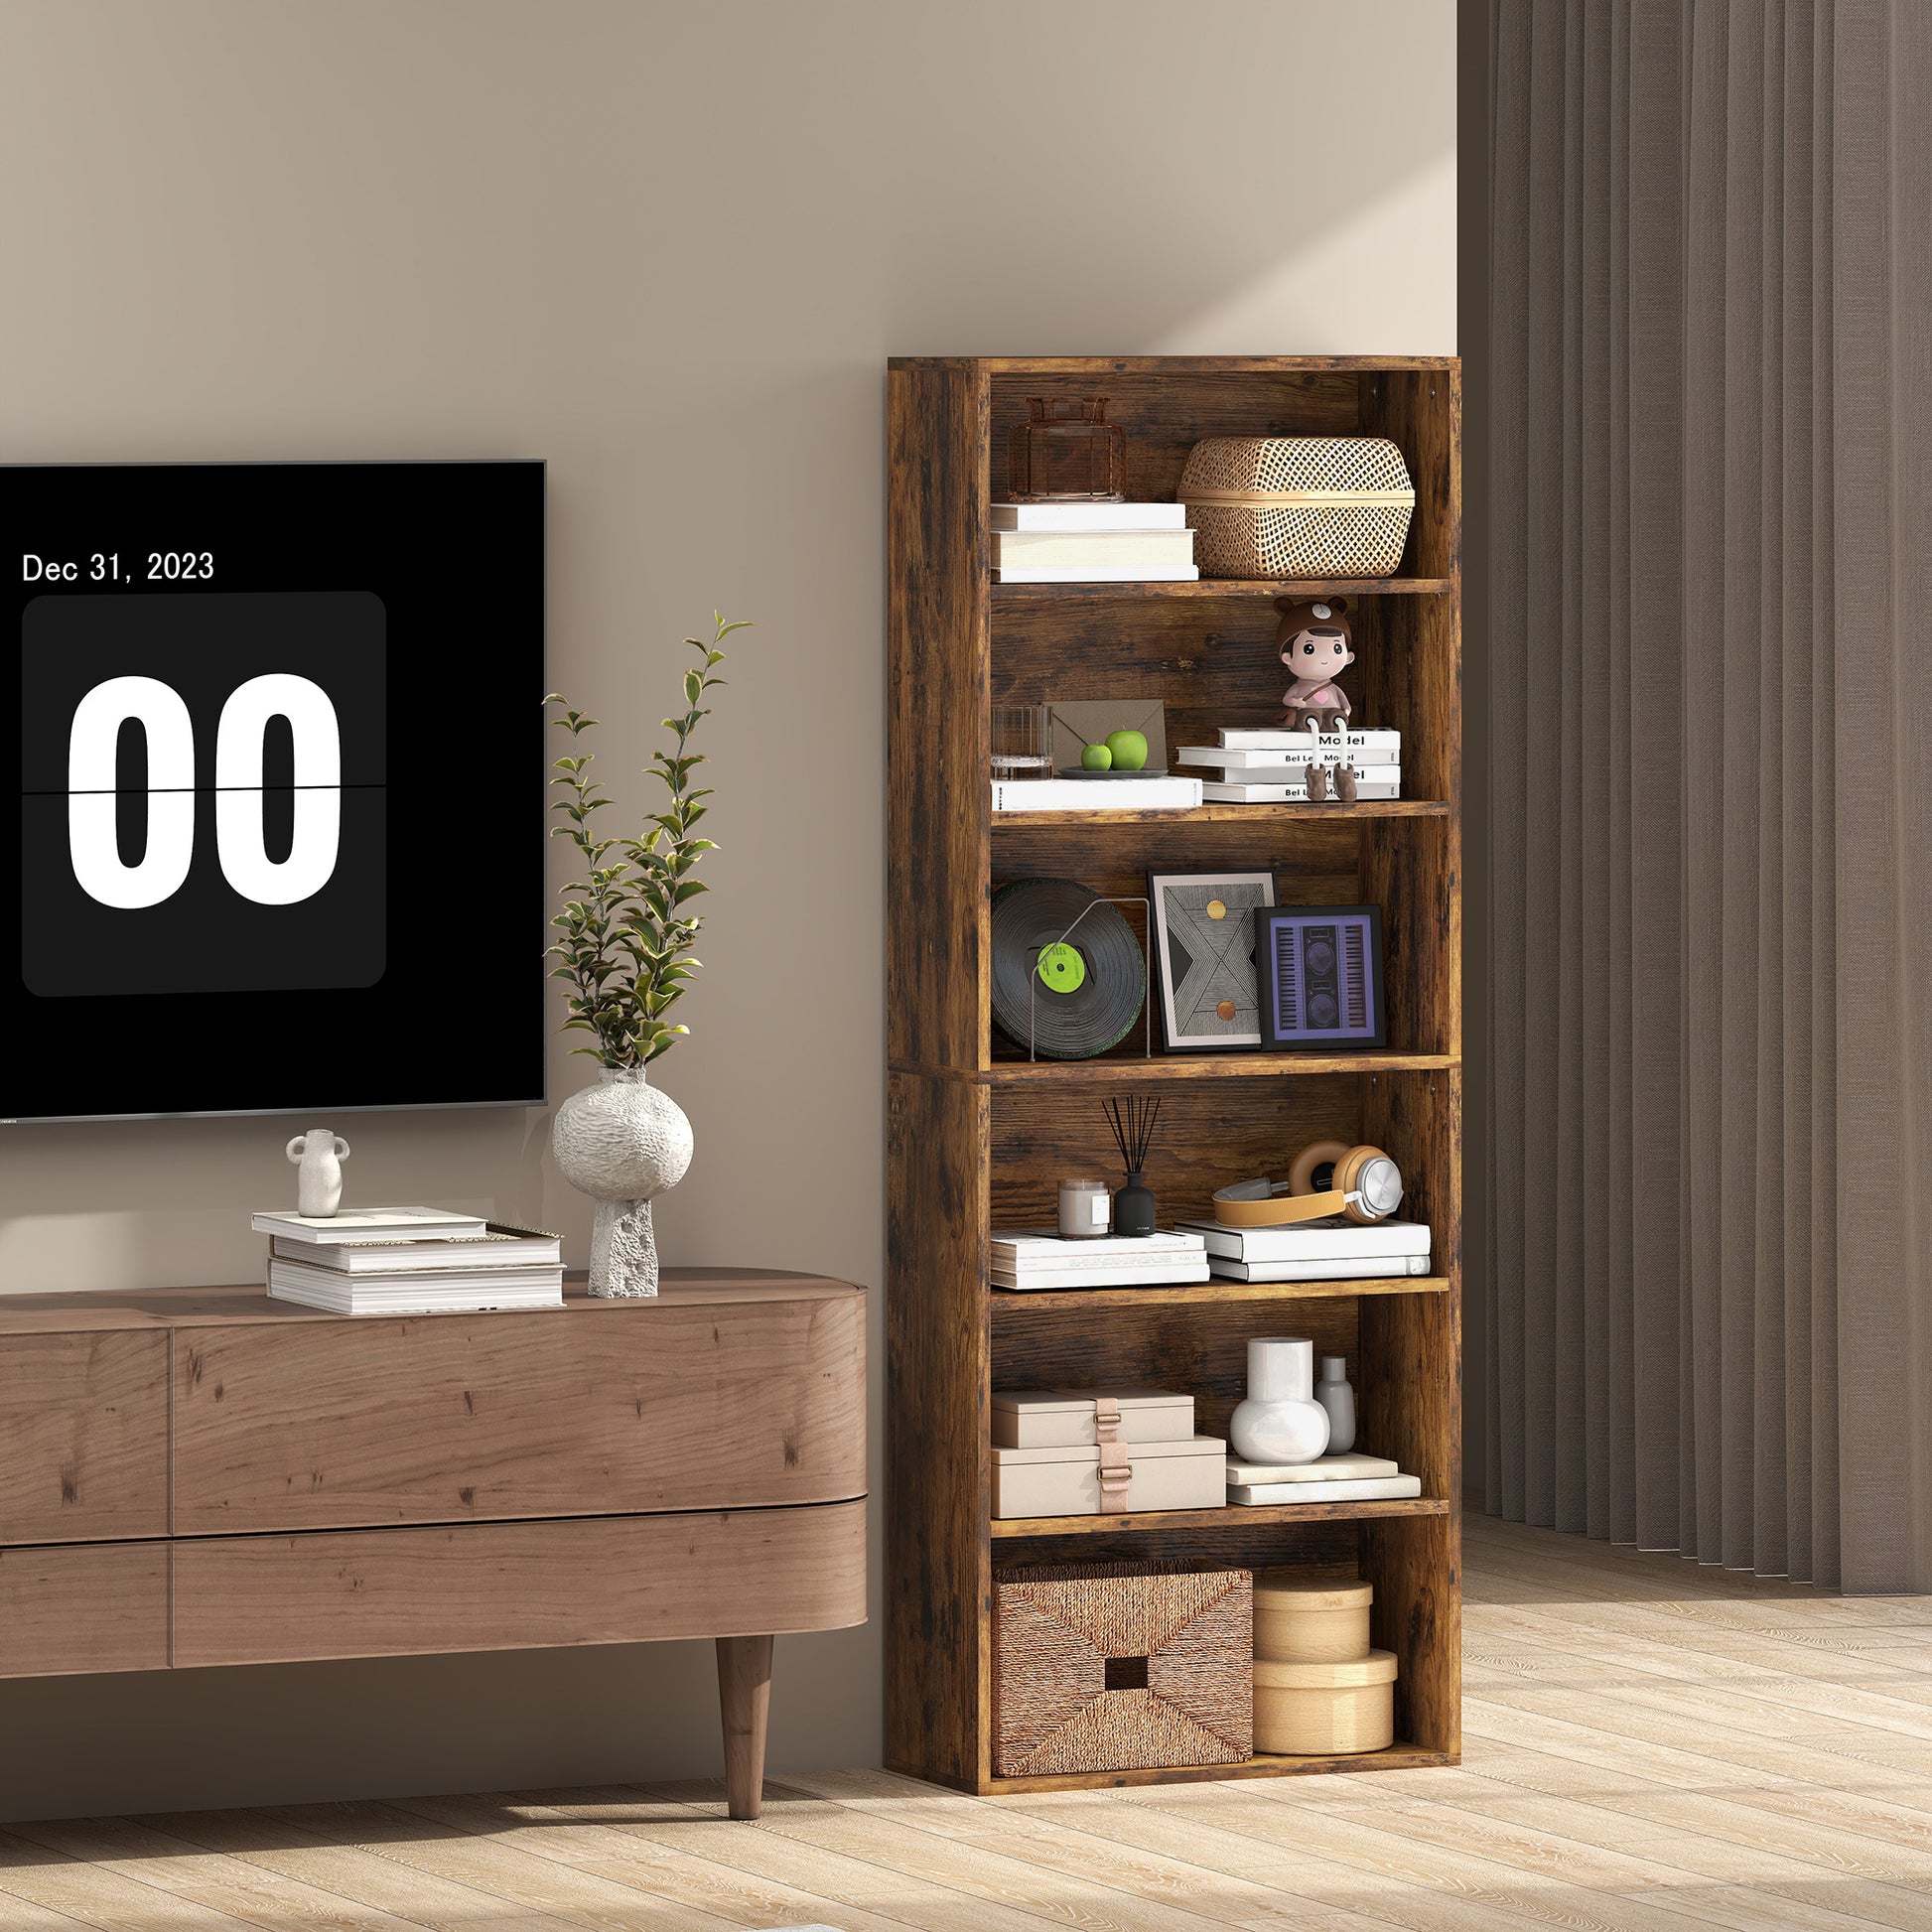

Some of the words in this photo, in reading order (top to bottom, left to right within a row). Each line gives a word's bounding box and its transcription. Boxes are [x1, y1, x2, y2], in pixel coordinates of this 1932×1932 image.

[23, 554, 78, 582] Dec
[89, 553, 131, 584] 31,
[147, 552, 214, 580] 2023
[68, 673, 342, 909] 00
